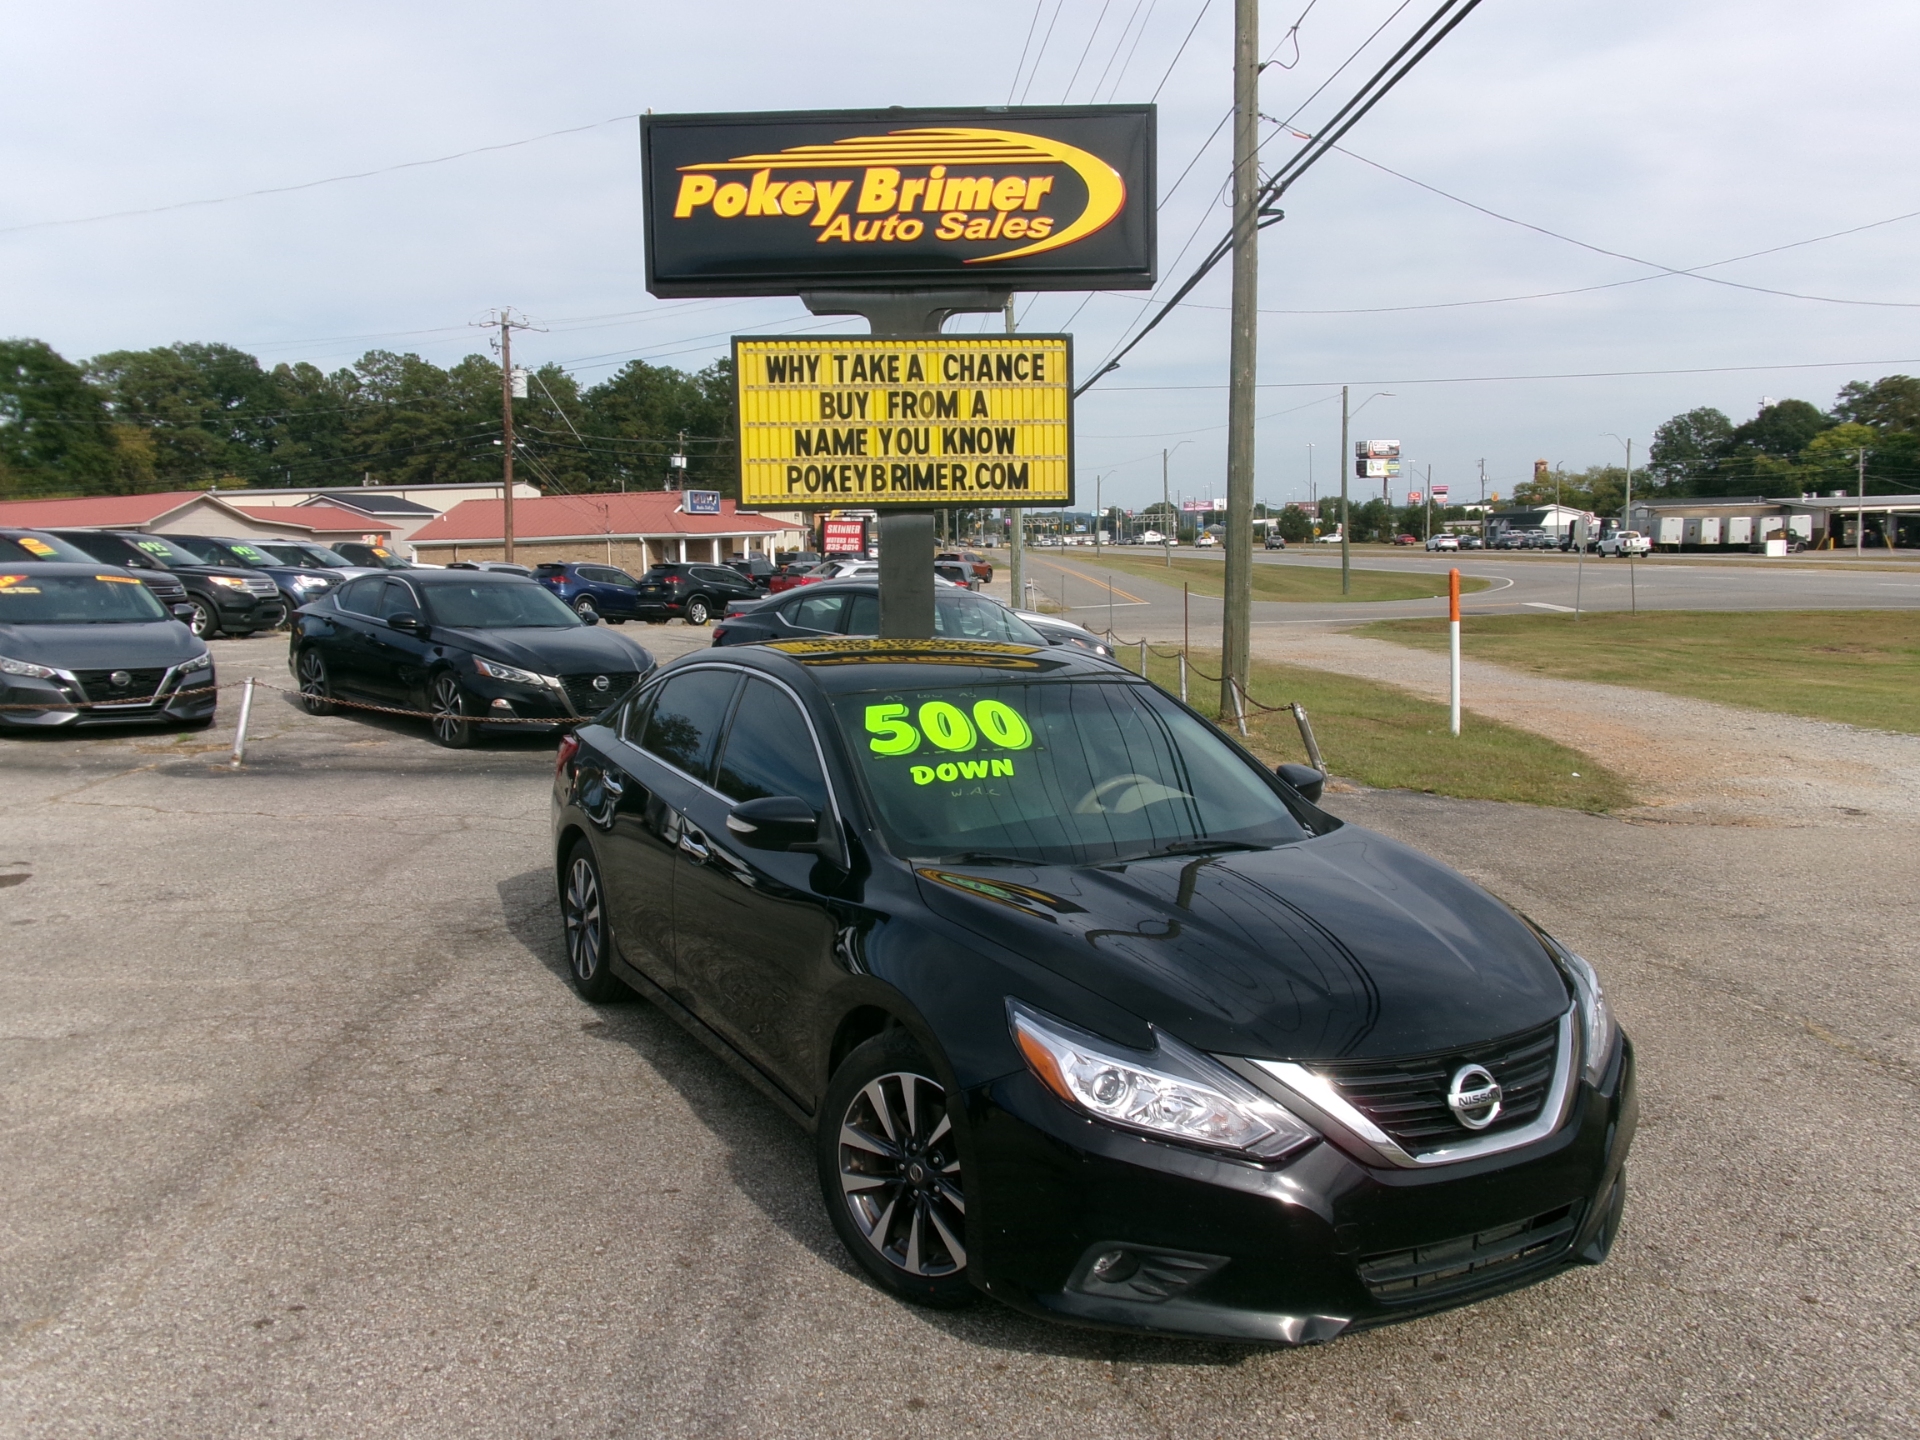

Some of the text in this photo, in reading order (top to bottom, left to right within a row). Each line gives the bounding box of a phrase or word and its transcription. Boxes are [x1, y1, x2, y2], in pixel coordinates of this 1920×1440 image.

[674, 165, 1055, 226] Pokey Brimer
[816, 211, 1056, 243] Auto Sales
[765, 355, 820, 384] WHY
[943, 353, 1045, 382] CHANCE
[820, 390, 989, 420] BUY FROM A
[795, 427, 1016, 457] NAME YOU KNOW
[787, 462, 1029, 493] POKEYBRIMER.COM
[827, 524, 861, 534] SKINNER
[864, 699, 1033, 756] 500
[909, 758, 1015, 786] DOWN
[1458, 1091, 1500, 1106] NISSAN
